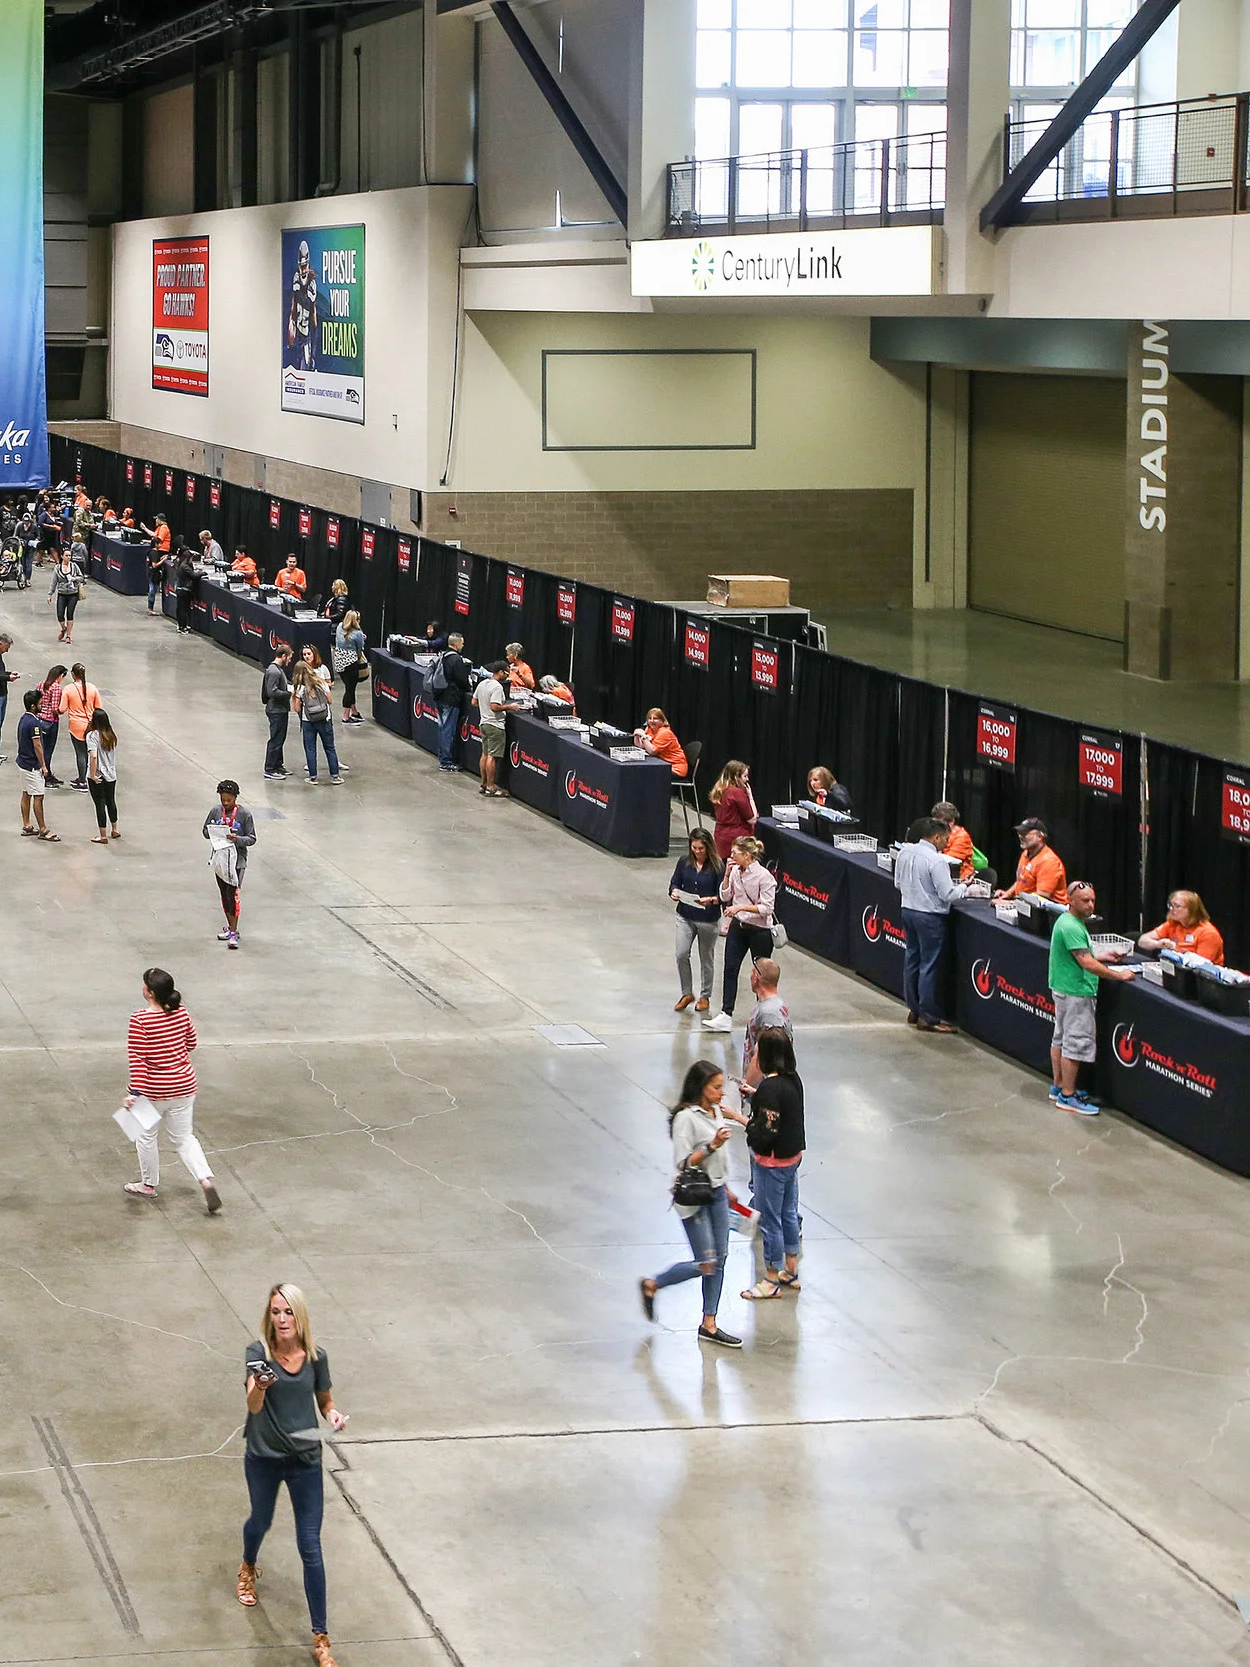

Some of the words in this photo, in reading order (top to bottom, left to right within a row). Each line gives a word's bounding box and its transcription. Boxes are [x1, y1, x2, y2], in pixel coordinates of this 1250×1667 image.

[156, 264, 176, 287] PROUD
[322, 249, 357, 284] PURSUE
[722, 246, 842, 288] CenturyLink
[163, 294, 172, 316] GO
[329, 289, 350, 318] YOUR
[321, 321, 358, 359] DREAMS
[184, 342, 207, 359] TOYOTA
[1139, 319, 1169, 533] STADIUM
[559, 593, 573, 603] 12,000
[615, 609, 631, 621] 13,000
[615, 625, 630, 637] 13,999
[688, 630, 706, 643] 14,000
[688, 648, 705, 660] 14,999
[755, 652, 775, 666] 15,000
[755, 670, 773, 683] 15,999
[982, 720, 1010, 737] 16,000
[982, 741, 1008, 758] 16,999
[1085, 748, 1114, 766] 17,000
[1096, 765, 1104, 773] TO
[1086, 771, 1114, 789] 17,999
[1226, 774, 1245, 786] CORRAL
[783, 872, 804, 891] Rock
[810, 885, 830, 903] Roll
[785, 886, 809, 902] MARATHON
[810, 898, 827, 911] SERIES
[882, 919, 906, 938] Rock
[996, 975, 1026, 999] Rock
[1000, 991, 1034, 1013] MARATHON
[1141, 1041, 1175, 1069] Rock
[1187, 1062, 1217, 1090] Roll
[1146, 1060, 1185, 1085] MARATHON
[1186, 1079, 1213, 1098] SERIES
